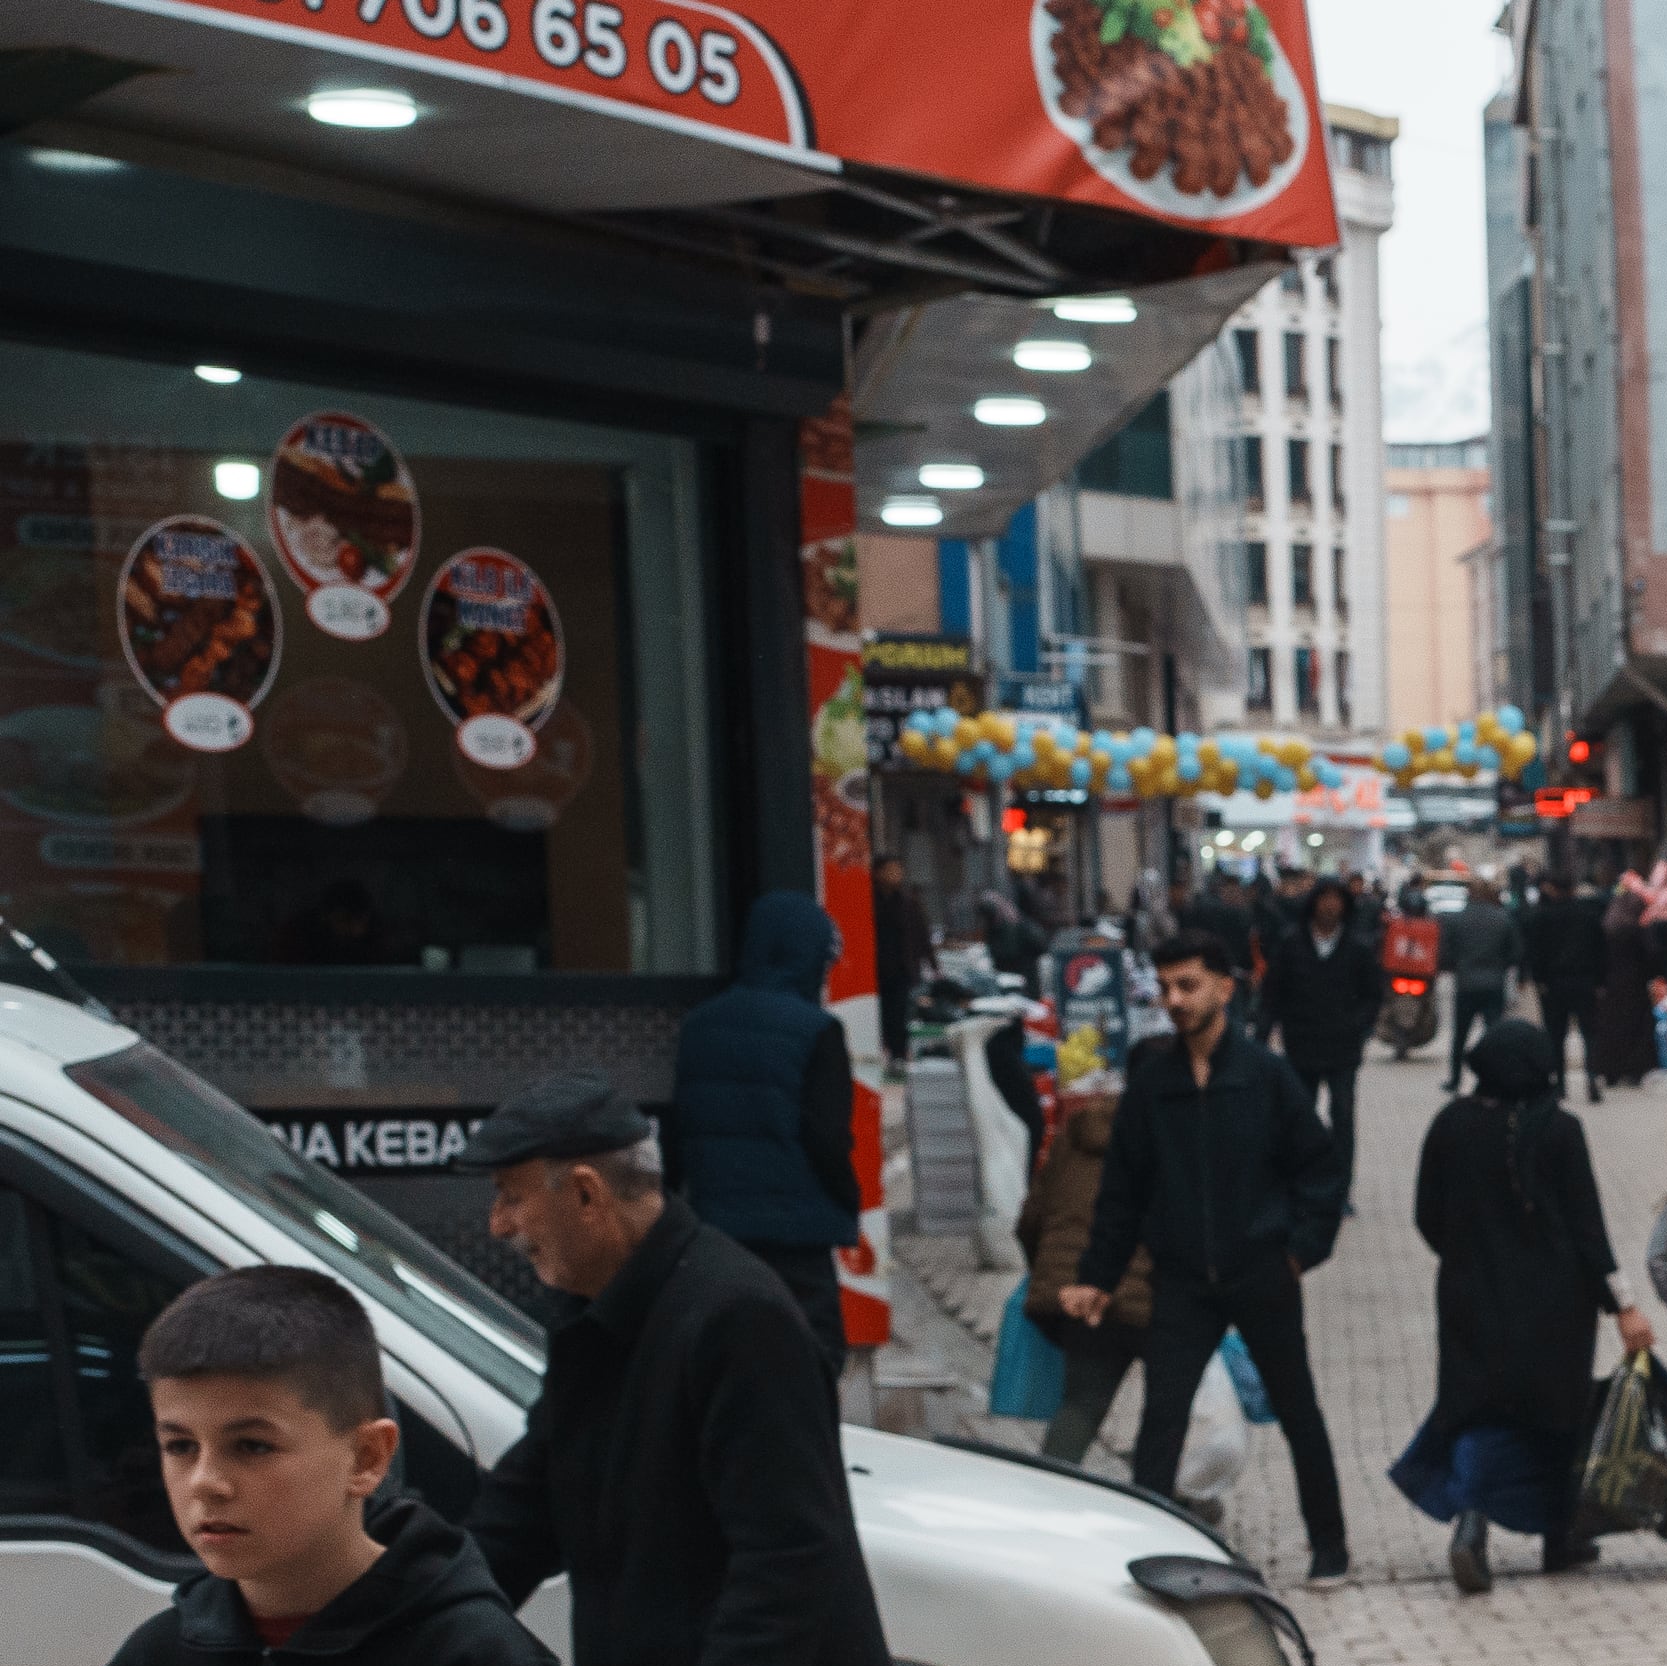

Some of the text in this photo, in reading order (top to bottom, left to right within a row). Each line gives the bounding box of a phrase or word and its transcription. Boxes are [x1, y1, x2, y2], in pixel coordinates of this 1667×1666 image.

[532, 0, 627, 79] 65
[647, 17, 741, 106] 05
[344, 1119, 481, 1168] KEBA
